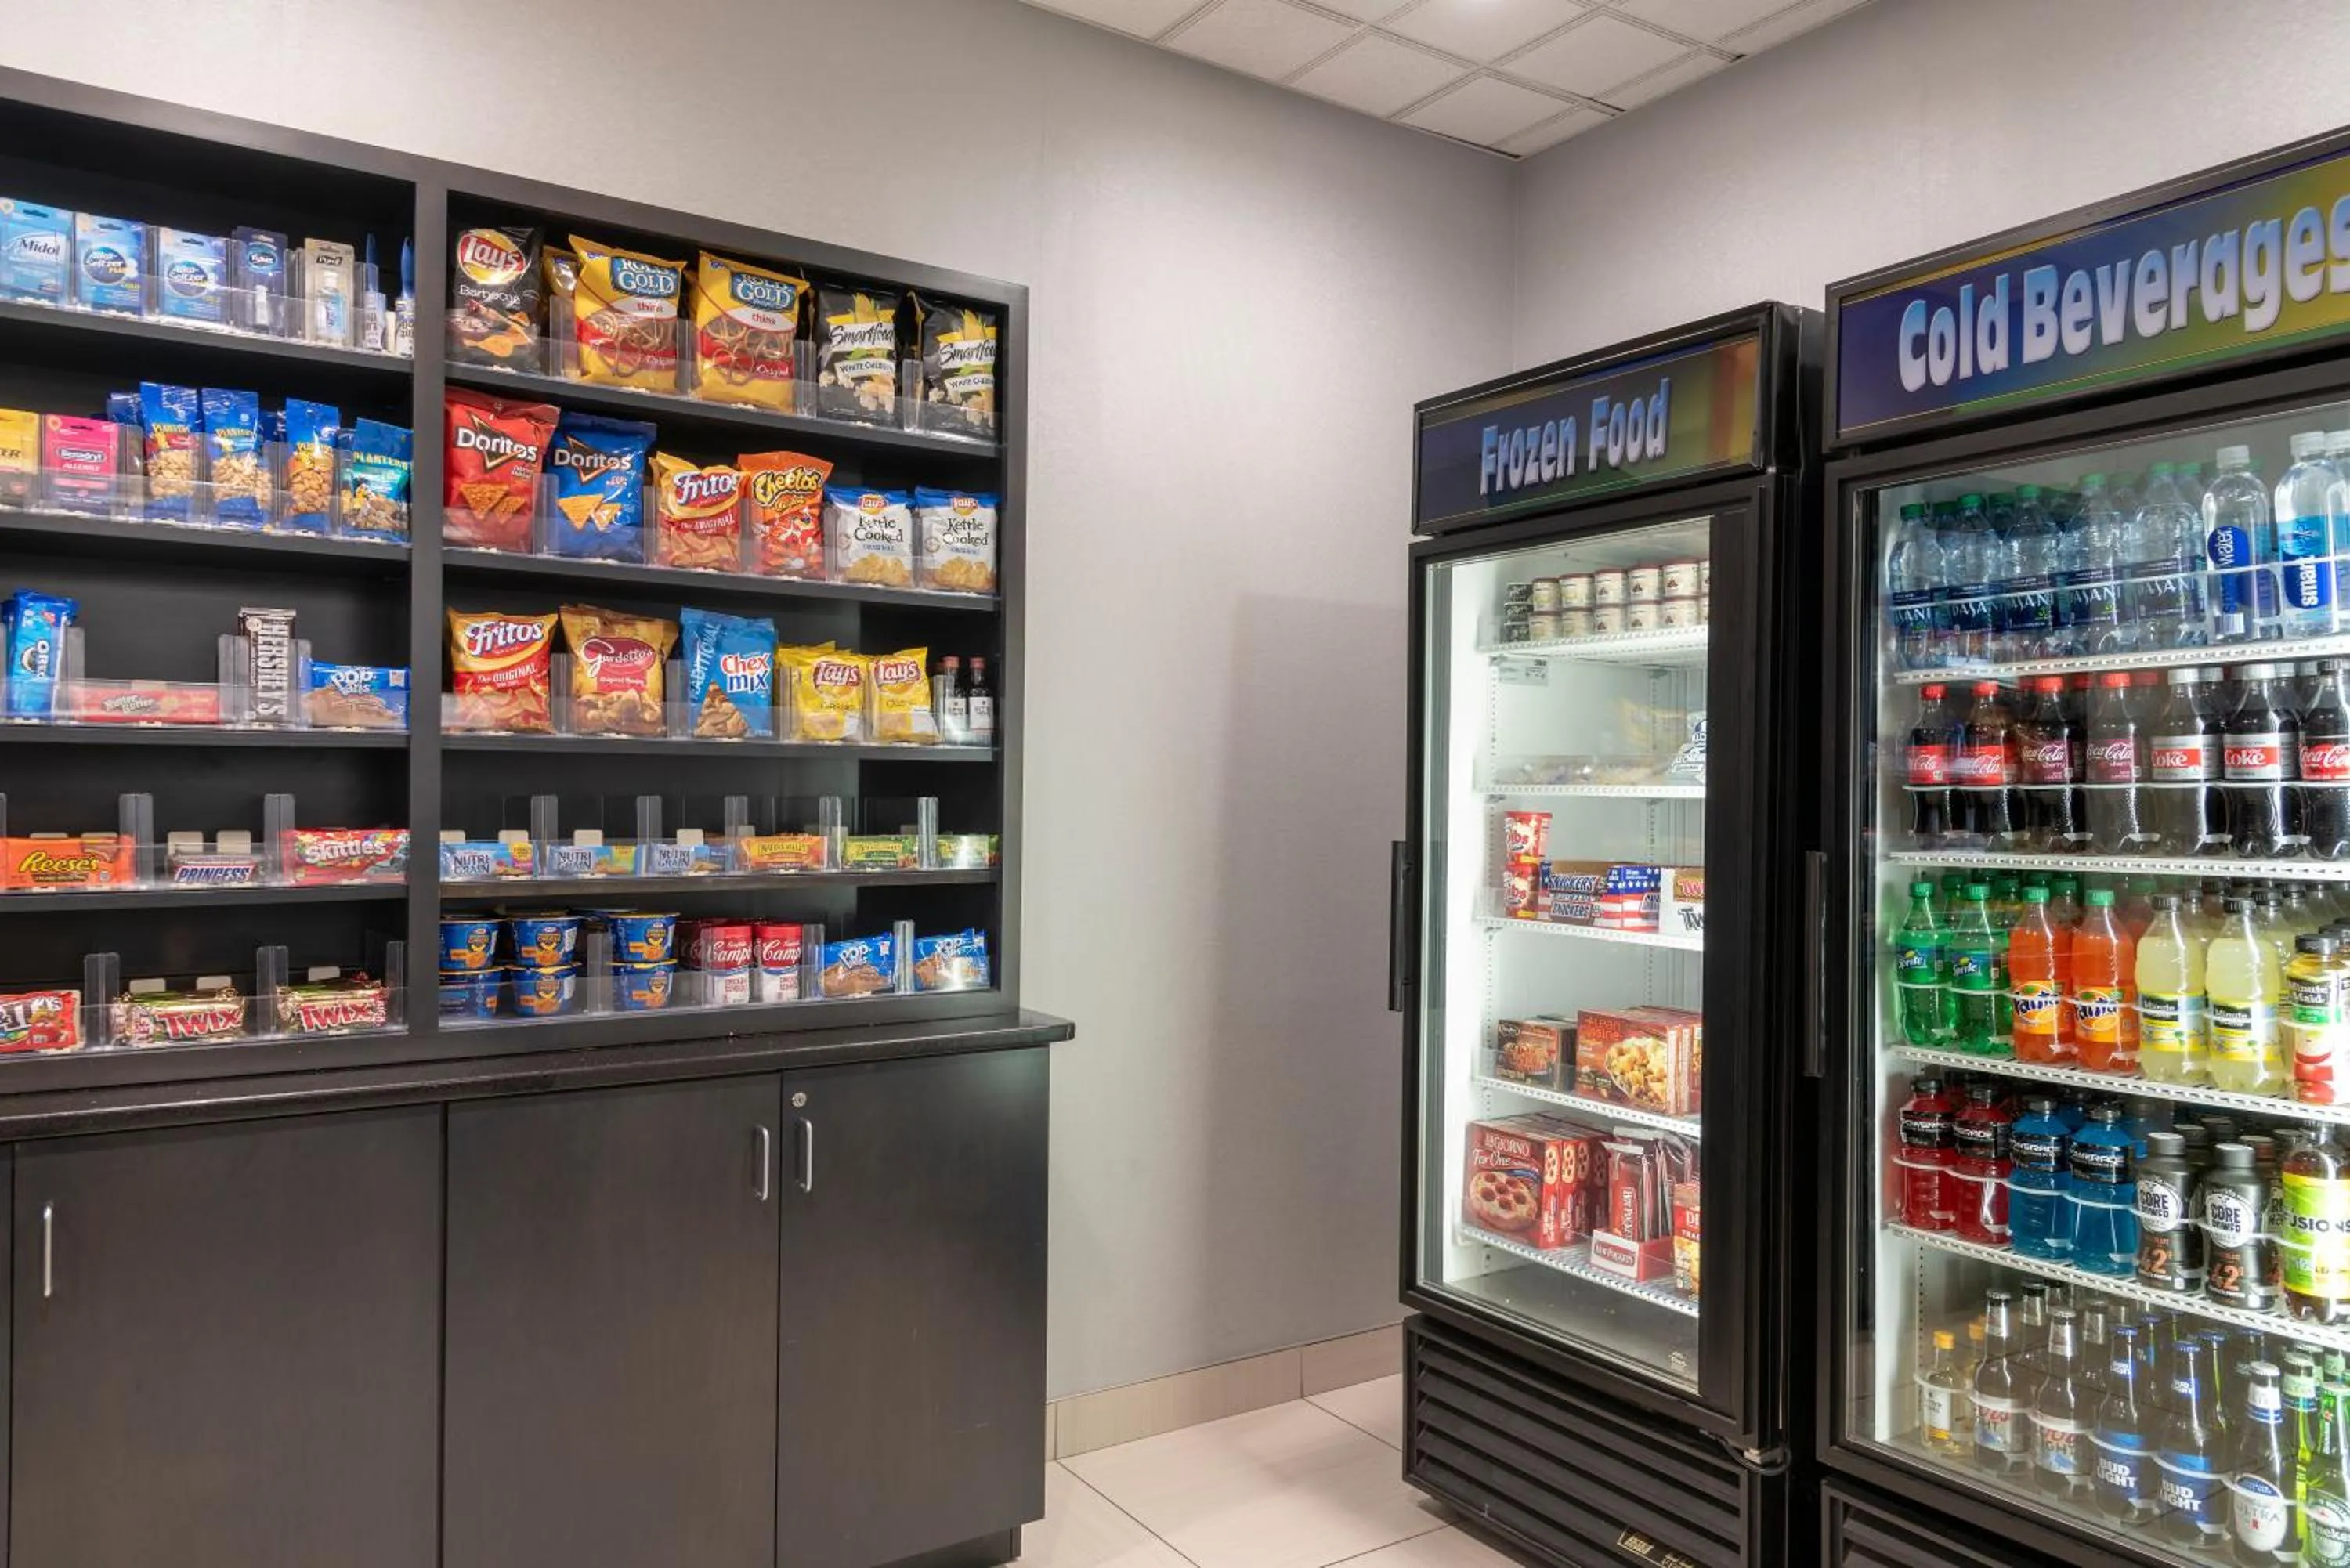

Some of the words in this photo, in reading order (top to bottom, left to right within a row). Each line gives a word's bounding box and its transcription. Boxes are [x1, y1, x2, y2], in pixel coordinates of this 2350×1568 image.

[20, 238, 60, 256] Midol
[619, 270, 674, 294] GOLD
[460, 284, 521, 305] Barbecue
[736, 283, 790, 308] GOLD
[1899, 273, 2009, 392] Cold
[2022, 194, 2350, 363] Beverages
[457, 427, 538, 461] Doritos
[1480, 415, 1576, 495] Frozen
[1589, 377, 1671, 471] Food
[353, 451, 409, 470] PLANTERS
[553, 448, 631, 471] Doritos
[754, 468, 822, 504] Cheetos
[854, 527, 904, 544] Cooked
[946, 518, 985, 533] Kettle
[942, 532, 989, 547] Cooked
[2007, 591, 2055, 612] ASANI
[465, 619, 545, 656] Fritos
[580, 638, 653, 677] Gardetto's
[720, 652, 772, 676] Chex
[258, 622, 289, 716] HERSHEY'S
[493, 663, 537, 682] ORIGINAL
[815, 660, 861, 688] Lay's
[877, 659, 921, 684] Lay's
[2151, 750, 2188, 768] Coke
[2225, 750, 2266, 768] Coke
[2300, 744, 2350, 768] Coca-Co
[306, 839, 386, 864] Skittles
[454, 854, 490, 865] NUTRI
[559, 851, 592, 862] NUTRI
[175, 865, 251, 883] PRINCESS
[454, 865, 490, 876] GRAIN
[1549, 875, 1596, 892] SNICKERS
[1678, 907, 1704, 931] TW
[2143, 1000, 2175, 1011] Minute
[2215, 1009, 2248, 1019] Minute
[2140, 1190, 2169, 1210] CORE
[2211, 1205, 2241, 1224] CORE
[2096, 1465, 2138, 1489] LIGHT
[2099, 1457, 2131, 1478] BUD
[2161, 1478, 2194, 1499] BUD
[2159, 1488, 2203, 1512] LIGHT
